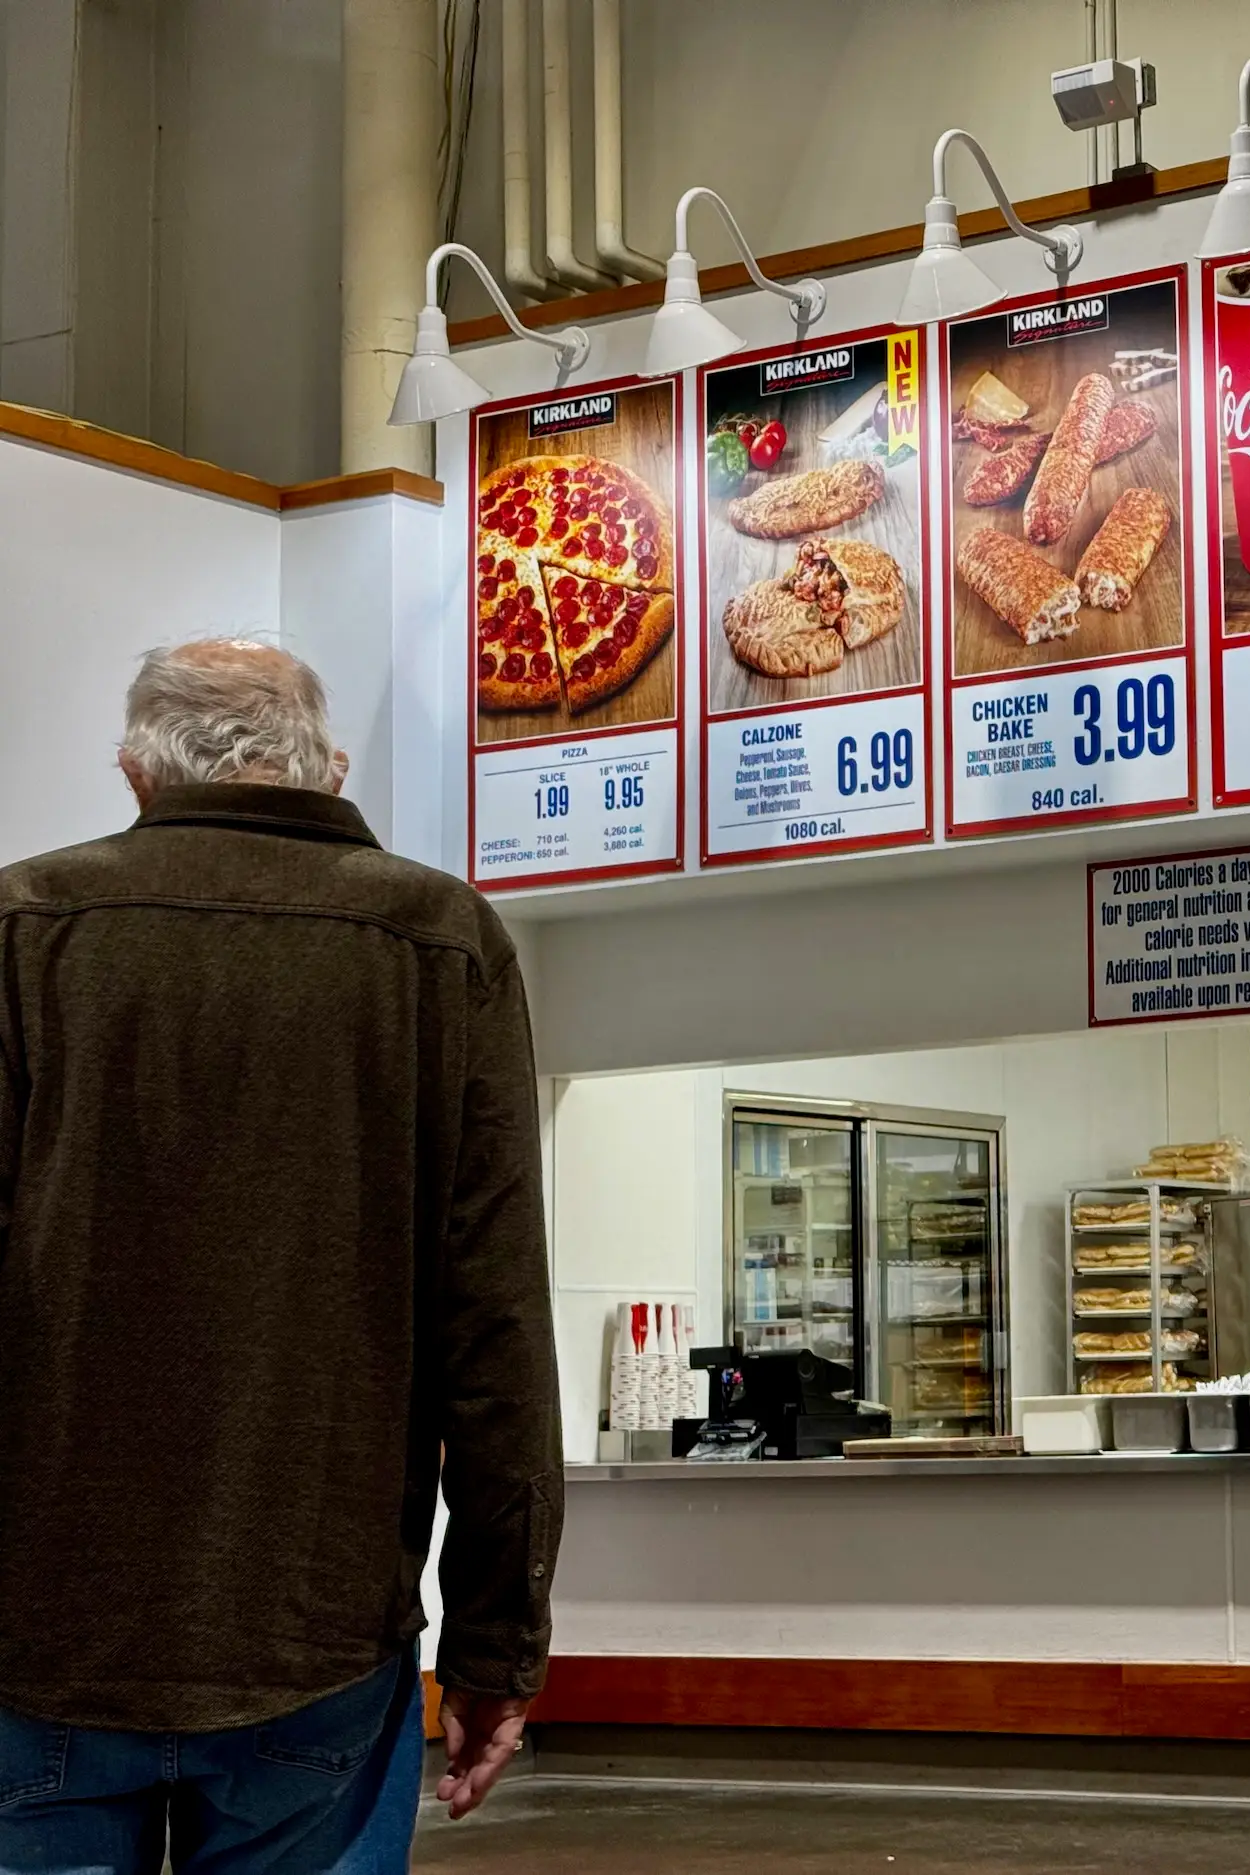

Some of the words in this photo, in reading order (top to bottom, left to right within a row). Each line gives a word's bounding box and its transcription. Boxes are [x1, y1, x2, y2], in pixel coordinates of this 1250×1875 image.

[1012, 299, 1104, 332] KIRKLAND
[765, 350, 850, 381] KIRKLAND
[890, 339, 917, 436] NEW
[533, 396, 612, 426] KIRKLAND
[972, 693, 1048, 722] CHICKEN
[1073, 673, 1176, 767] 3.99
[742, 722, 803, 747] CALZONE
[987, 719, 1034, 743] BAKE
[561, 747, 588, 759] PIZZA
[837, 728, 913, 796] 6.99
[966, 763, 992, 778] BACON,
[993, 759, 1020, 774] CAESAR
[1021, 755, 1056, 772] DRESSING
[967, 748, 996, 763] CHICKEN
[539, 772, 566, 784] SLICE
[616, 761, 650, 774] WHOLE
[763, 766, 787, 780] Tomato
[534, 785, 569, 820] 1.99
[604, 776, 644, 811] 9.95
[747, 802, 759, 816] and
[760, 798, 801, 815] Mushrooms
[1032, 788, 1064, 811] 840
[1070, 784, 1104, 807] cal.
[481, 838, 521, 852] CHEESE:
[536, 835, 553, 846] 710
[554, 833, 570, 843] cal.
[603, 826, 627, 837] 4,260
[629, 824, 645, 834] cal.
[785, 821, 817, 841] 1080
[820, 818, 846, 837] cal.
[481, 851, 536, 866] PEPPERONI:
[536, 849, 553, 860] 650
[554, 847, 570, 857] cal.
[629, 838, 645, 849] cal.
[1112, 867, 1150, 896] 2000
[1155, 861, 1214, 891] Calories
[1218, 863, 1227, 884] a
[1101, 901, 1122, 926] for
[1126, 895, 1179, 927] general
[1183, 888, 1243, 917] nutrition
[1144, 923, 1194, 951] calorie
[1198, 919, 1239, 946] needs
[1105, 954, 1172, 985] Additional
[1177, 949, 1236, 978] nutrition
[1132, 983, 1193, 1012] available
[1197, 982, 1230, 1010] upon
